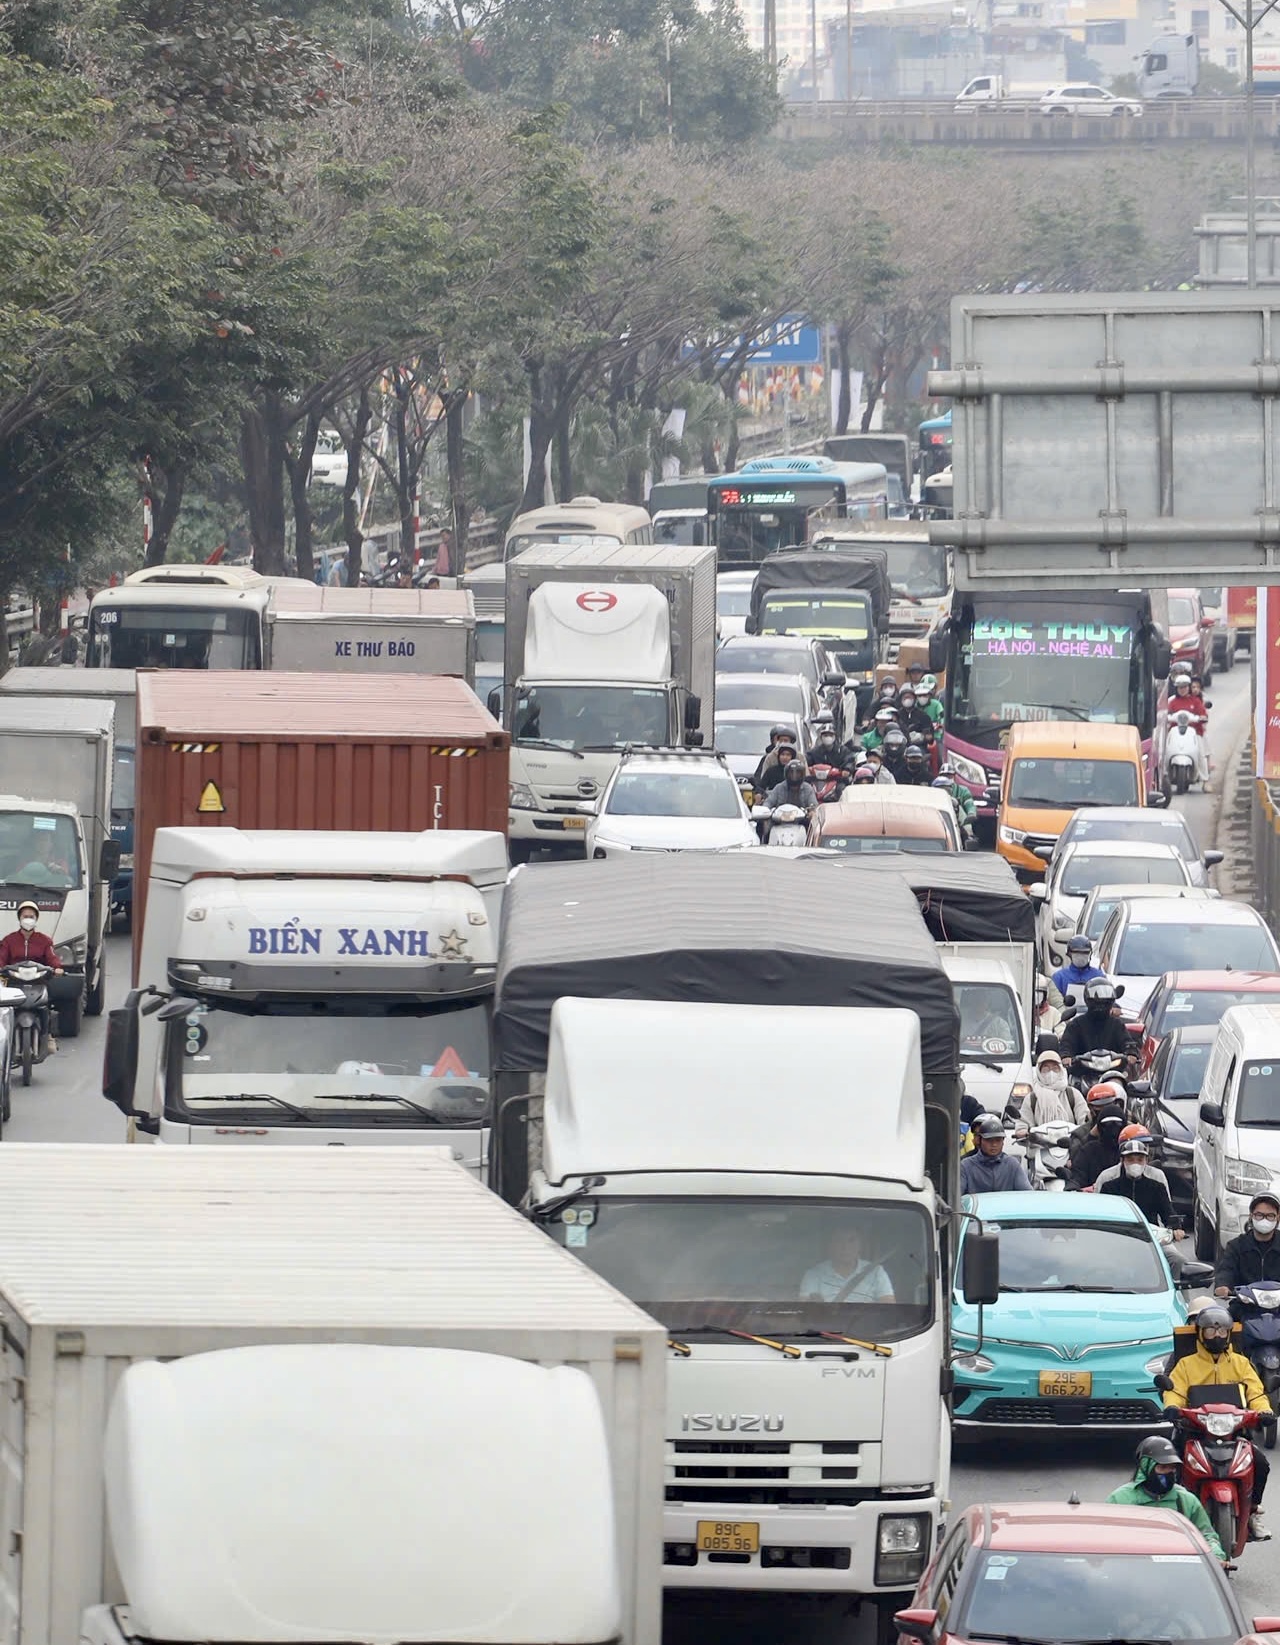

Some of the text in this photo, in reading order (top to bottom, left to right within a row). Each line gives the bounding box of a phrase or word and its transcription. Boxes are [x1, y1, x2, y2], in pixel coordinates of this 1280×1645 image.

[100, 611, 118, 624] 206
[335, 640, 353, 657] XE
[356, 640, 384, 658] THƯ
[1093, 643, 1113, 656] AN
[248, 917, 430, 956] BIỂN XANH
[821, 1367, 876, 1378] FVM
[1054, 1372, 1076, 1384] 29E
[1043, 1384, 1086, 1396] 066.22
[682, 1413, 784, 1433] ISUZU
[715, 1523, 741, 1536] 89C
[703, 1536, 751, 1551] 085.96
